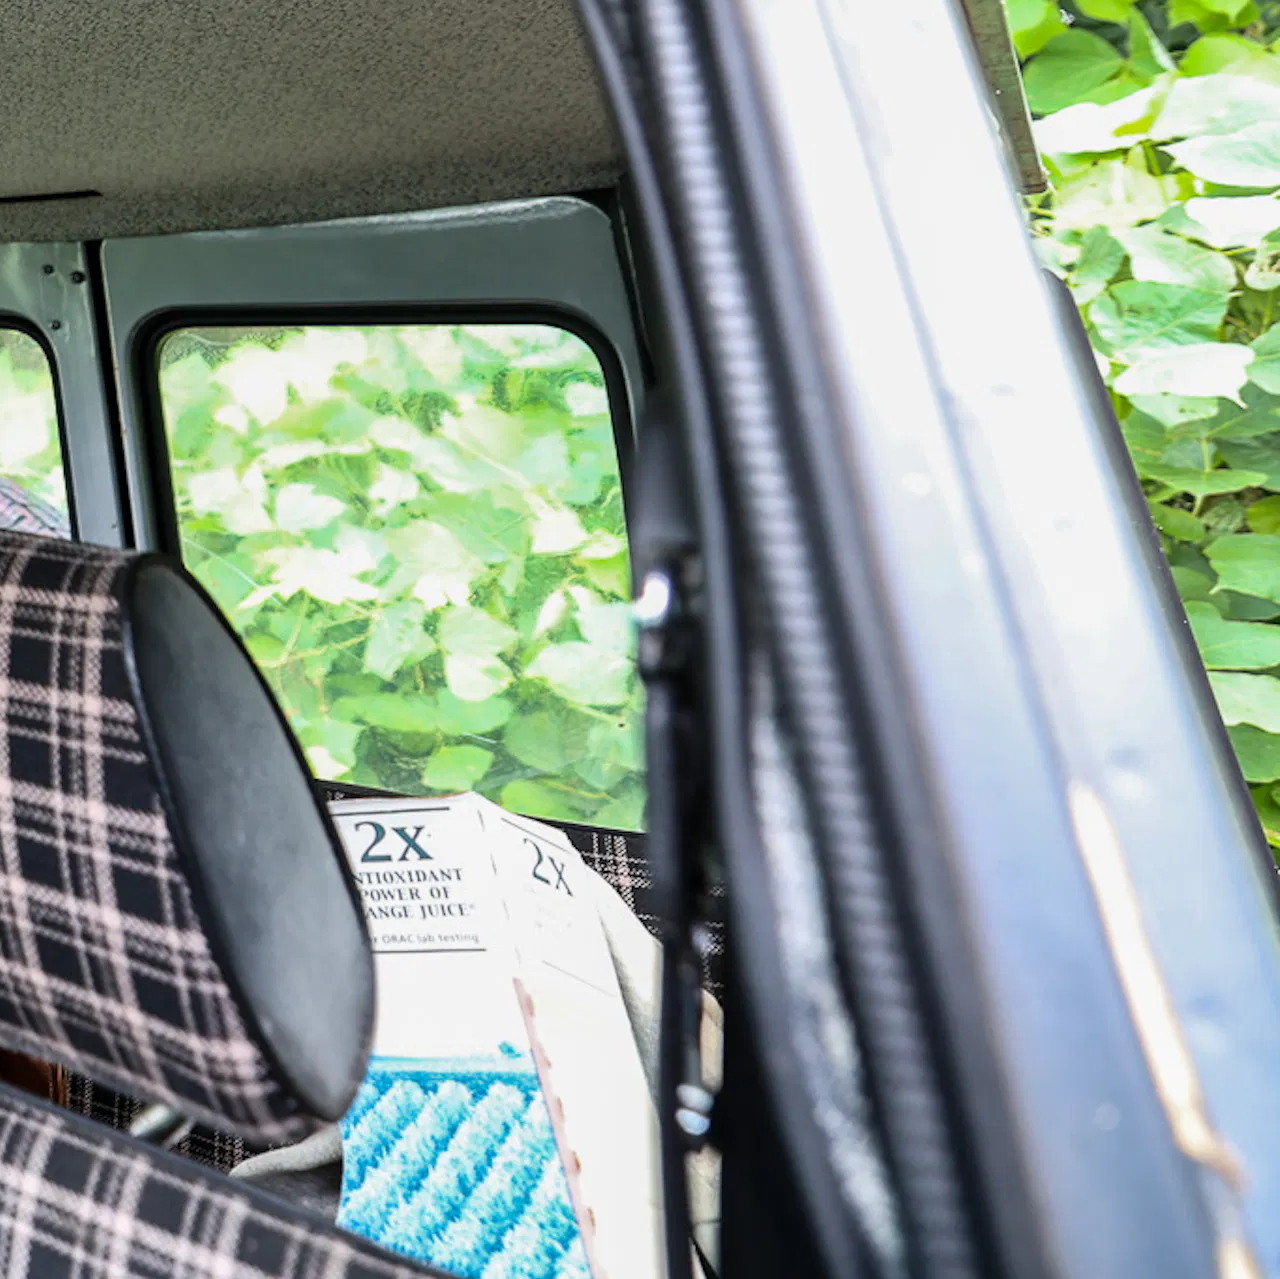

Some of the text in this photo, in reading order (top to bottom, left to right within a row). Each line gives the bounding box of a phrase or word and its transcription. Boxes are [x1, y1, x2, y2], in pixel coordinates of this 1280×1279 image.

[352, 868, 463, 886] NTIOXIDANT
[361, 886, 452, 903] POWER OF
[365, 904, 414, 920] ANGE
[417, 932, 435, 944] lab
[438, 932, 480, 945] testing
